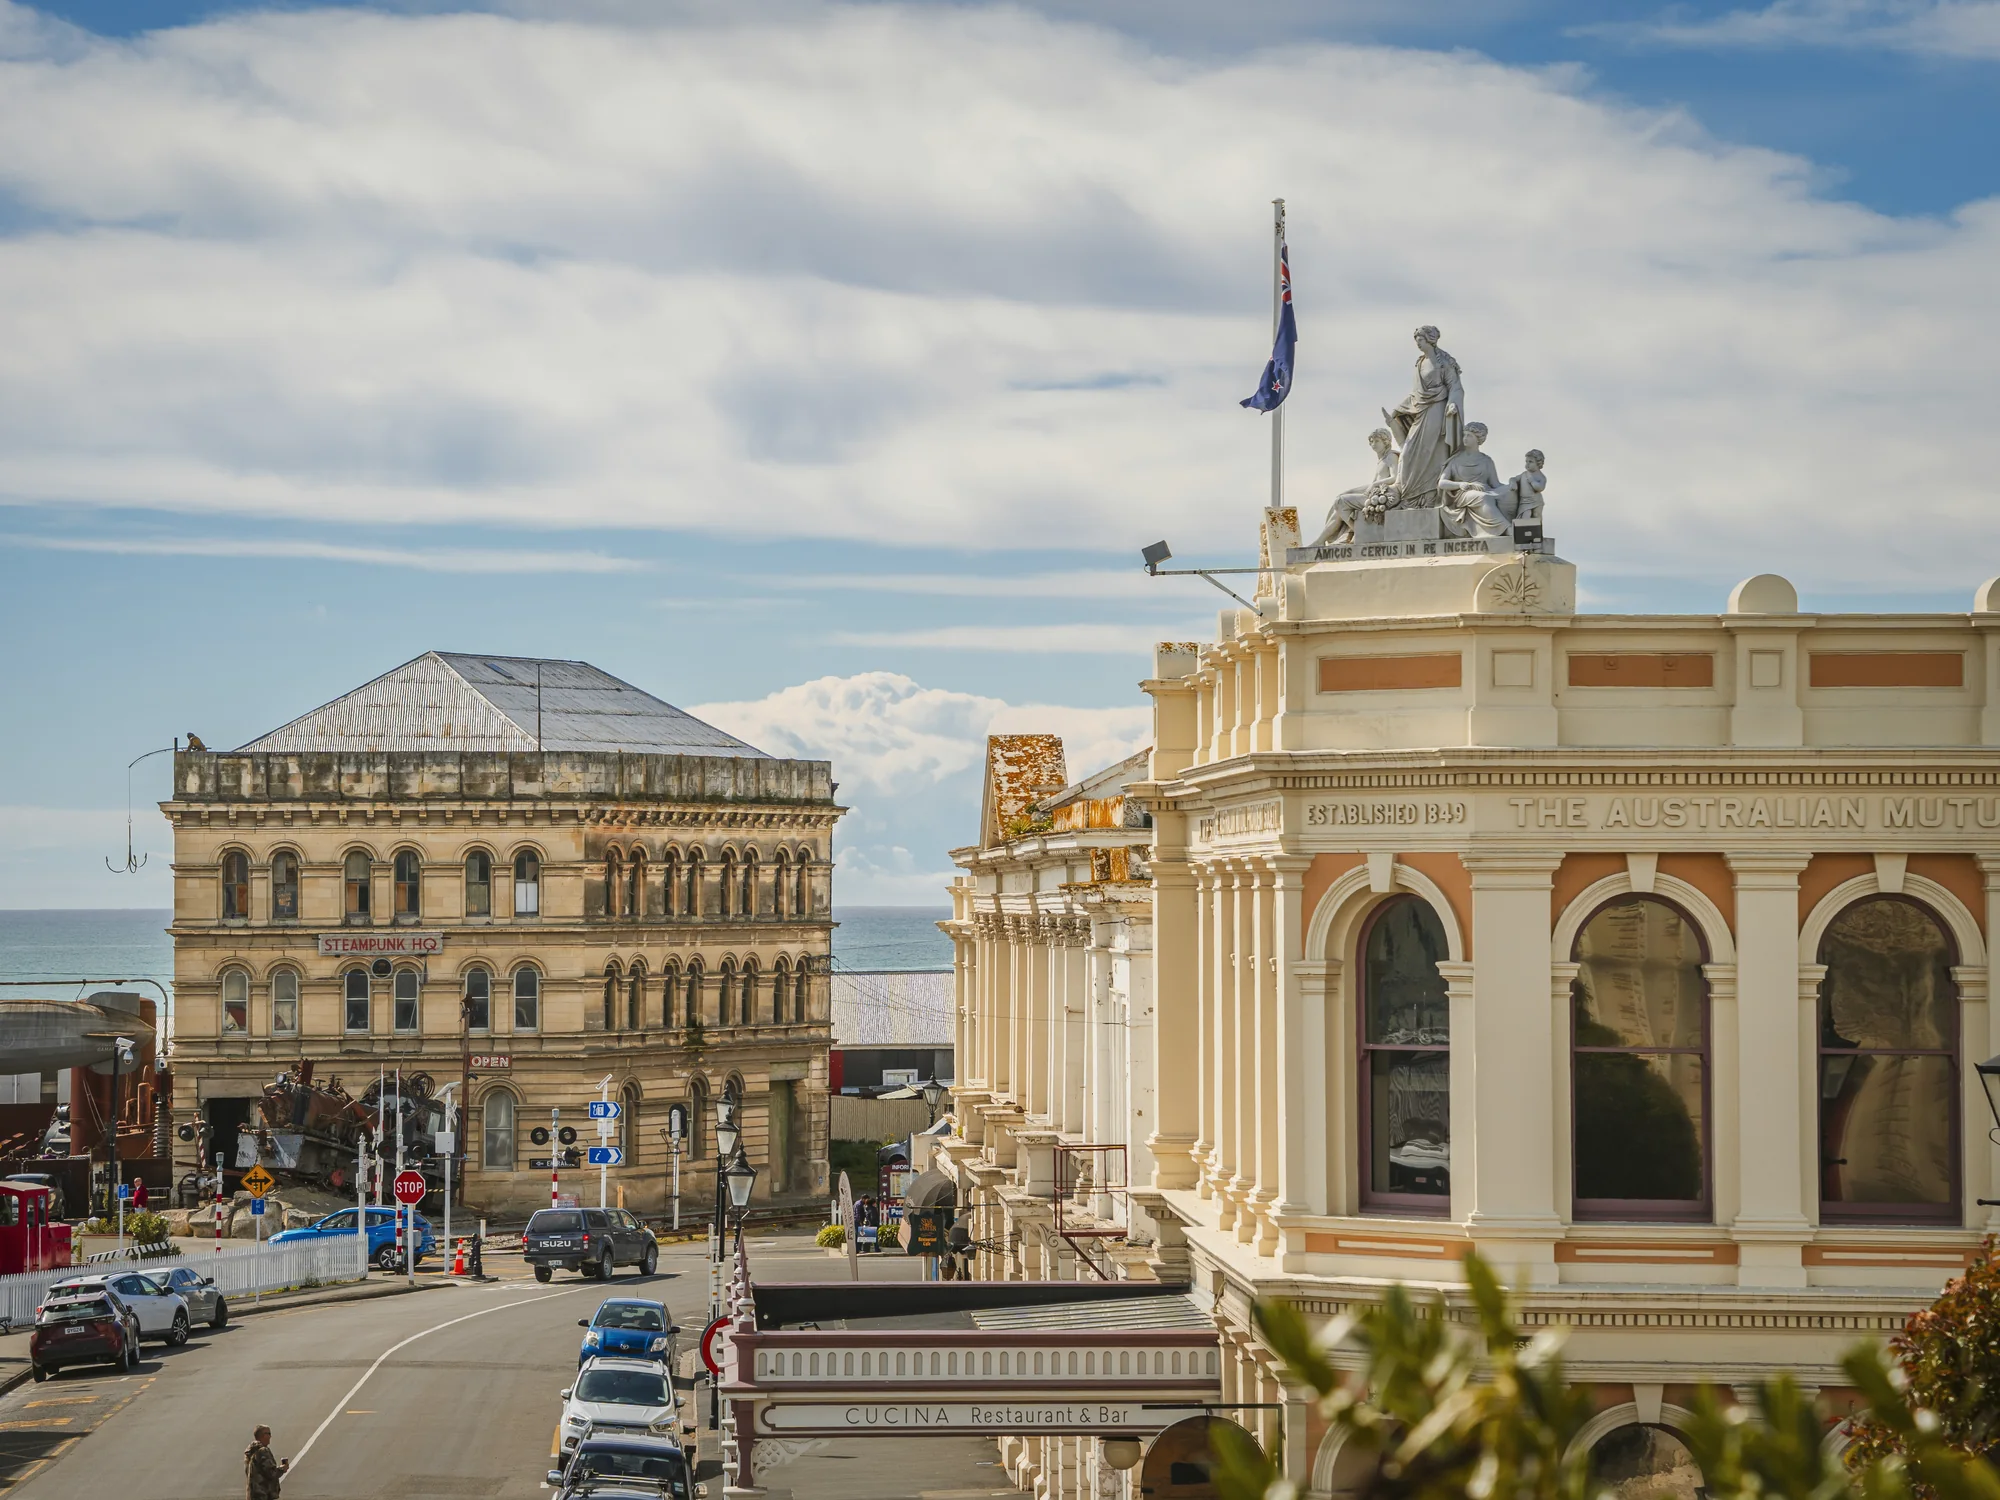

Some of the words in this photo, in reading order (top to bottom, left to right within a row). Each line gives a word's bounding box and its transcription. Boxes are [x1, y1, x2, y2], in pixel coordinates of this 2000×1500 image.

[1314, 546, 1353, 560] AMICUS
[1361, 545, 1398, 557] CERTUS
[1406, 544, 1416, 555] IN
[1423, 543, 1436, 554] RE
[1444, 541, 1489, 554] INCERTA
[1307, 803, 1418, 825] ESTABLISHED
[1424, 803, 1465, 824] 1849
[1508, 797, 1589, 828] THE
[1605, 797, 1867, 828] AUSTRALIAN
[324, 938, 405, 951] STEAMPUNK
[412, 937, 437, 951] HQ
[471, 1056, 509, 1067] OPEN
[396, 1181, 423, 1193] STOP
[539, 1240, 571, 1248] ISUZU
[845, 1407, 950, 1424] CUCINA
[971, 1406, 1073, 1424] Restaurant
[1079, 1407, 1092, 1423] &
[1100, 1406, 1128, 1423] Bar
